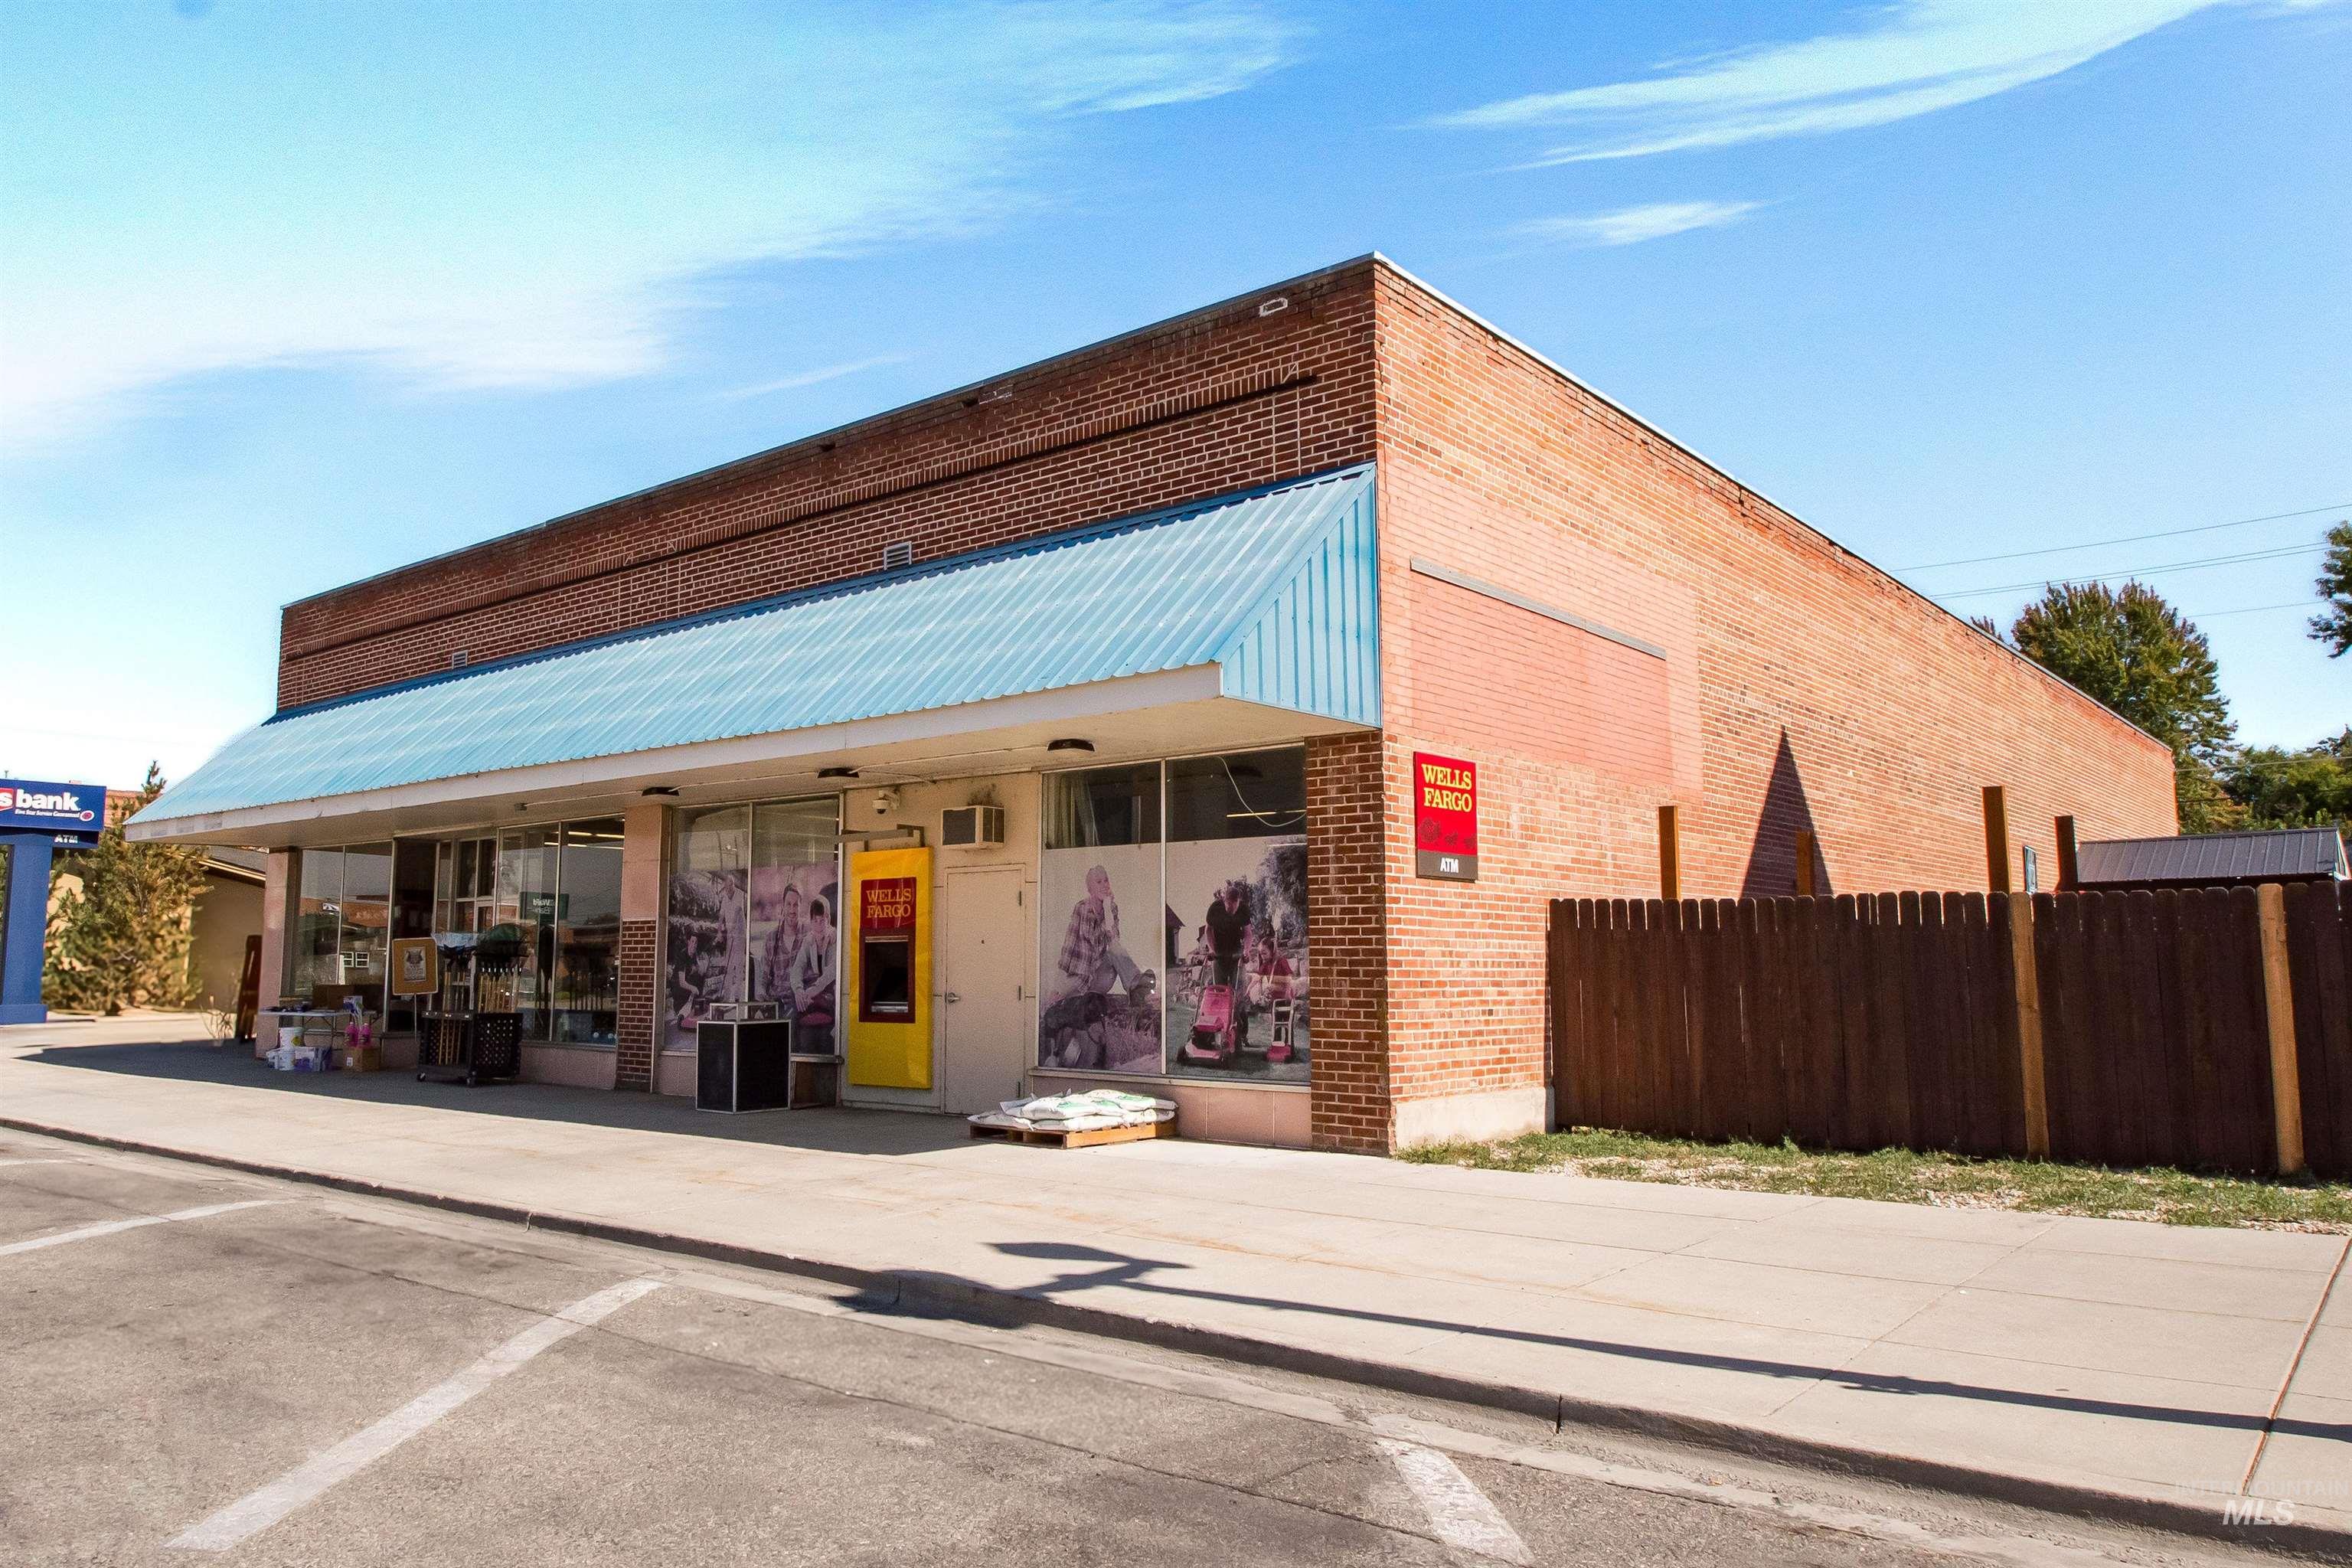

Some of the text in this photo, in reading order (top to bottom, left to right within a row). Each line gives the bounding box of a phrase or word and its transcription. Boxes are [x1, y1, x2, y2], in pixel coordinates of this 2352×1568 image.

[1421, 763, 1472, 790] WELLS
[16, 789, 79, 811] bank
[1423, 787, 1472, 812] FARGO
[54, 834, 78, 843] ATM
[1440, 858, 1459, 873] ATM
[866, 888, 912, 903] WELLS
[867, 903, 911, 918] FARGO
